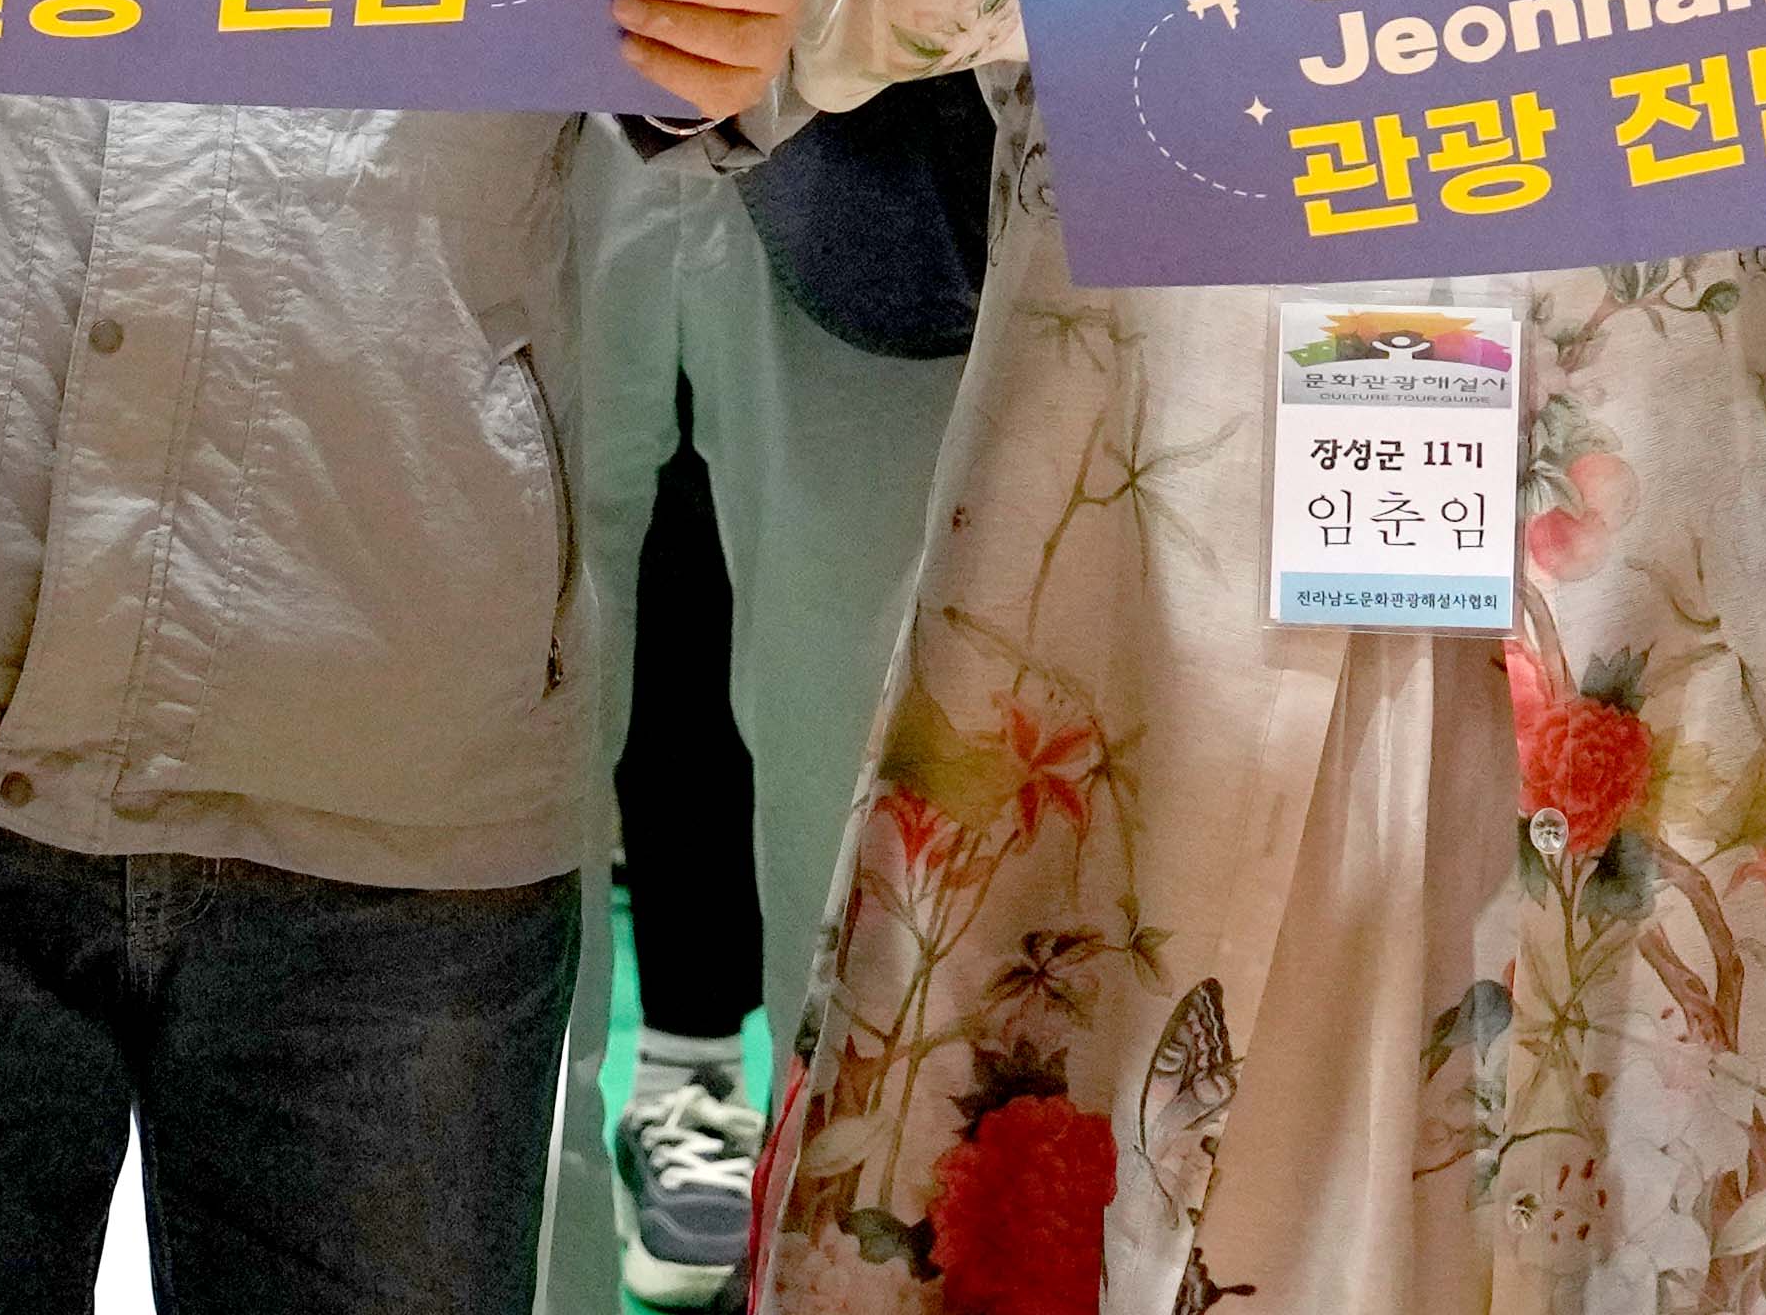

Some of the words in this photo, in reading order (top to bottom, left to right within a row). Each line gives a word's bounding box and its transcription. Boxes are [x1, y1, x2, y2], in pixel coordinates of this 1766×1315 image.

[1290, 91, 1560, 240] 관광
[1302, 372, 1509, 393] 문화관광해설사
[1320, 392, 1390, 402] CULTURE
[1394, 394, 1439, 403] TOUR
[1440, 395, 1490, 404] GUIDE
[1310, 439, 1405, 471] 장성군
[1423, 441, 1483, 469] 11기
[1307, 490, 1487, 551] 임춘임
[1296, 590, 1497, 610] 전라남도문화관광해설사협회
